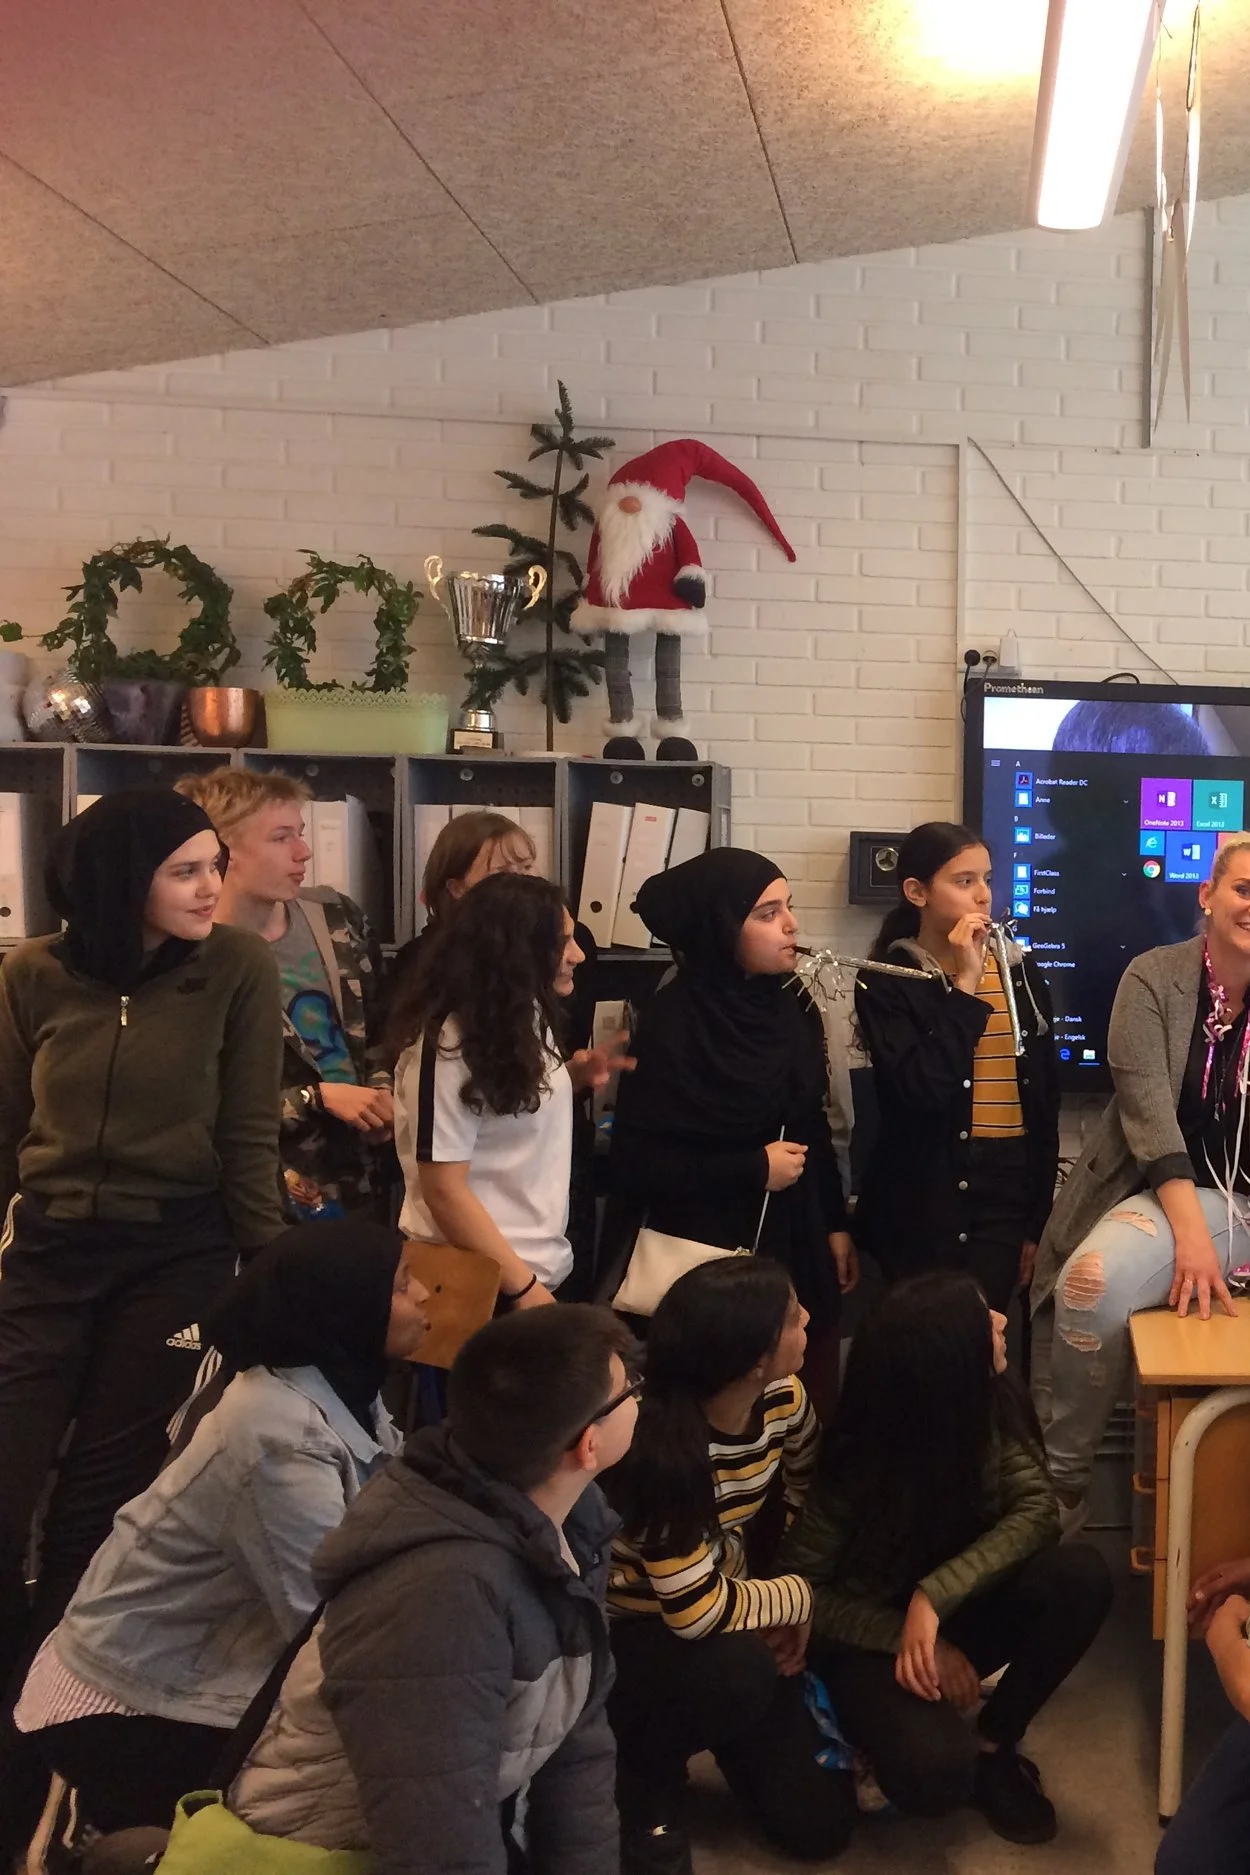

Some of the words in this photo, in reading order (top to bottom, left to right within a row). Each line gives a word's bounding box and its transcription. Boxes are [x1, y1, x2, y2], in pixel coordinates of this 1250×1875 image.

[984, 682, 1044, 694] Promethean
[1036, 961, 1053, 969] oogle
[166, 1338, 202, 1350] adidas
